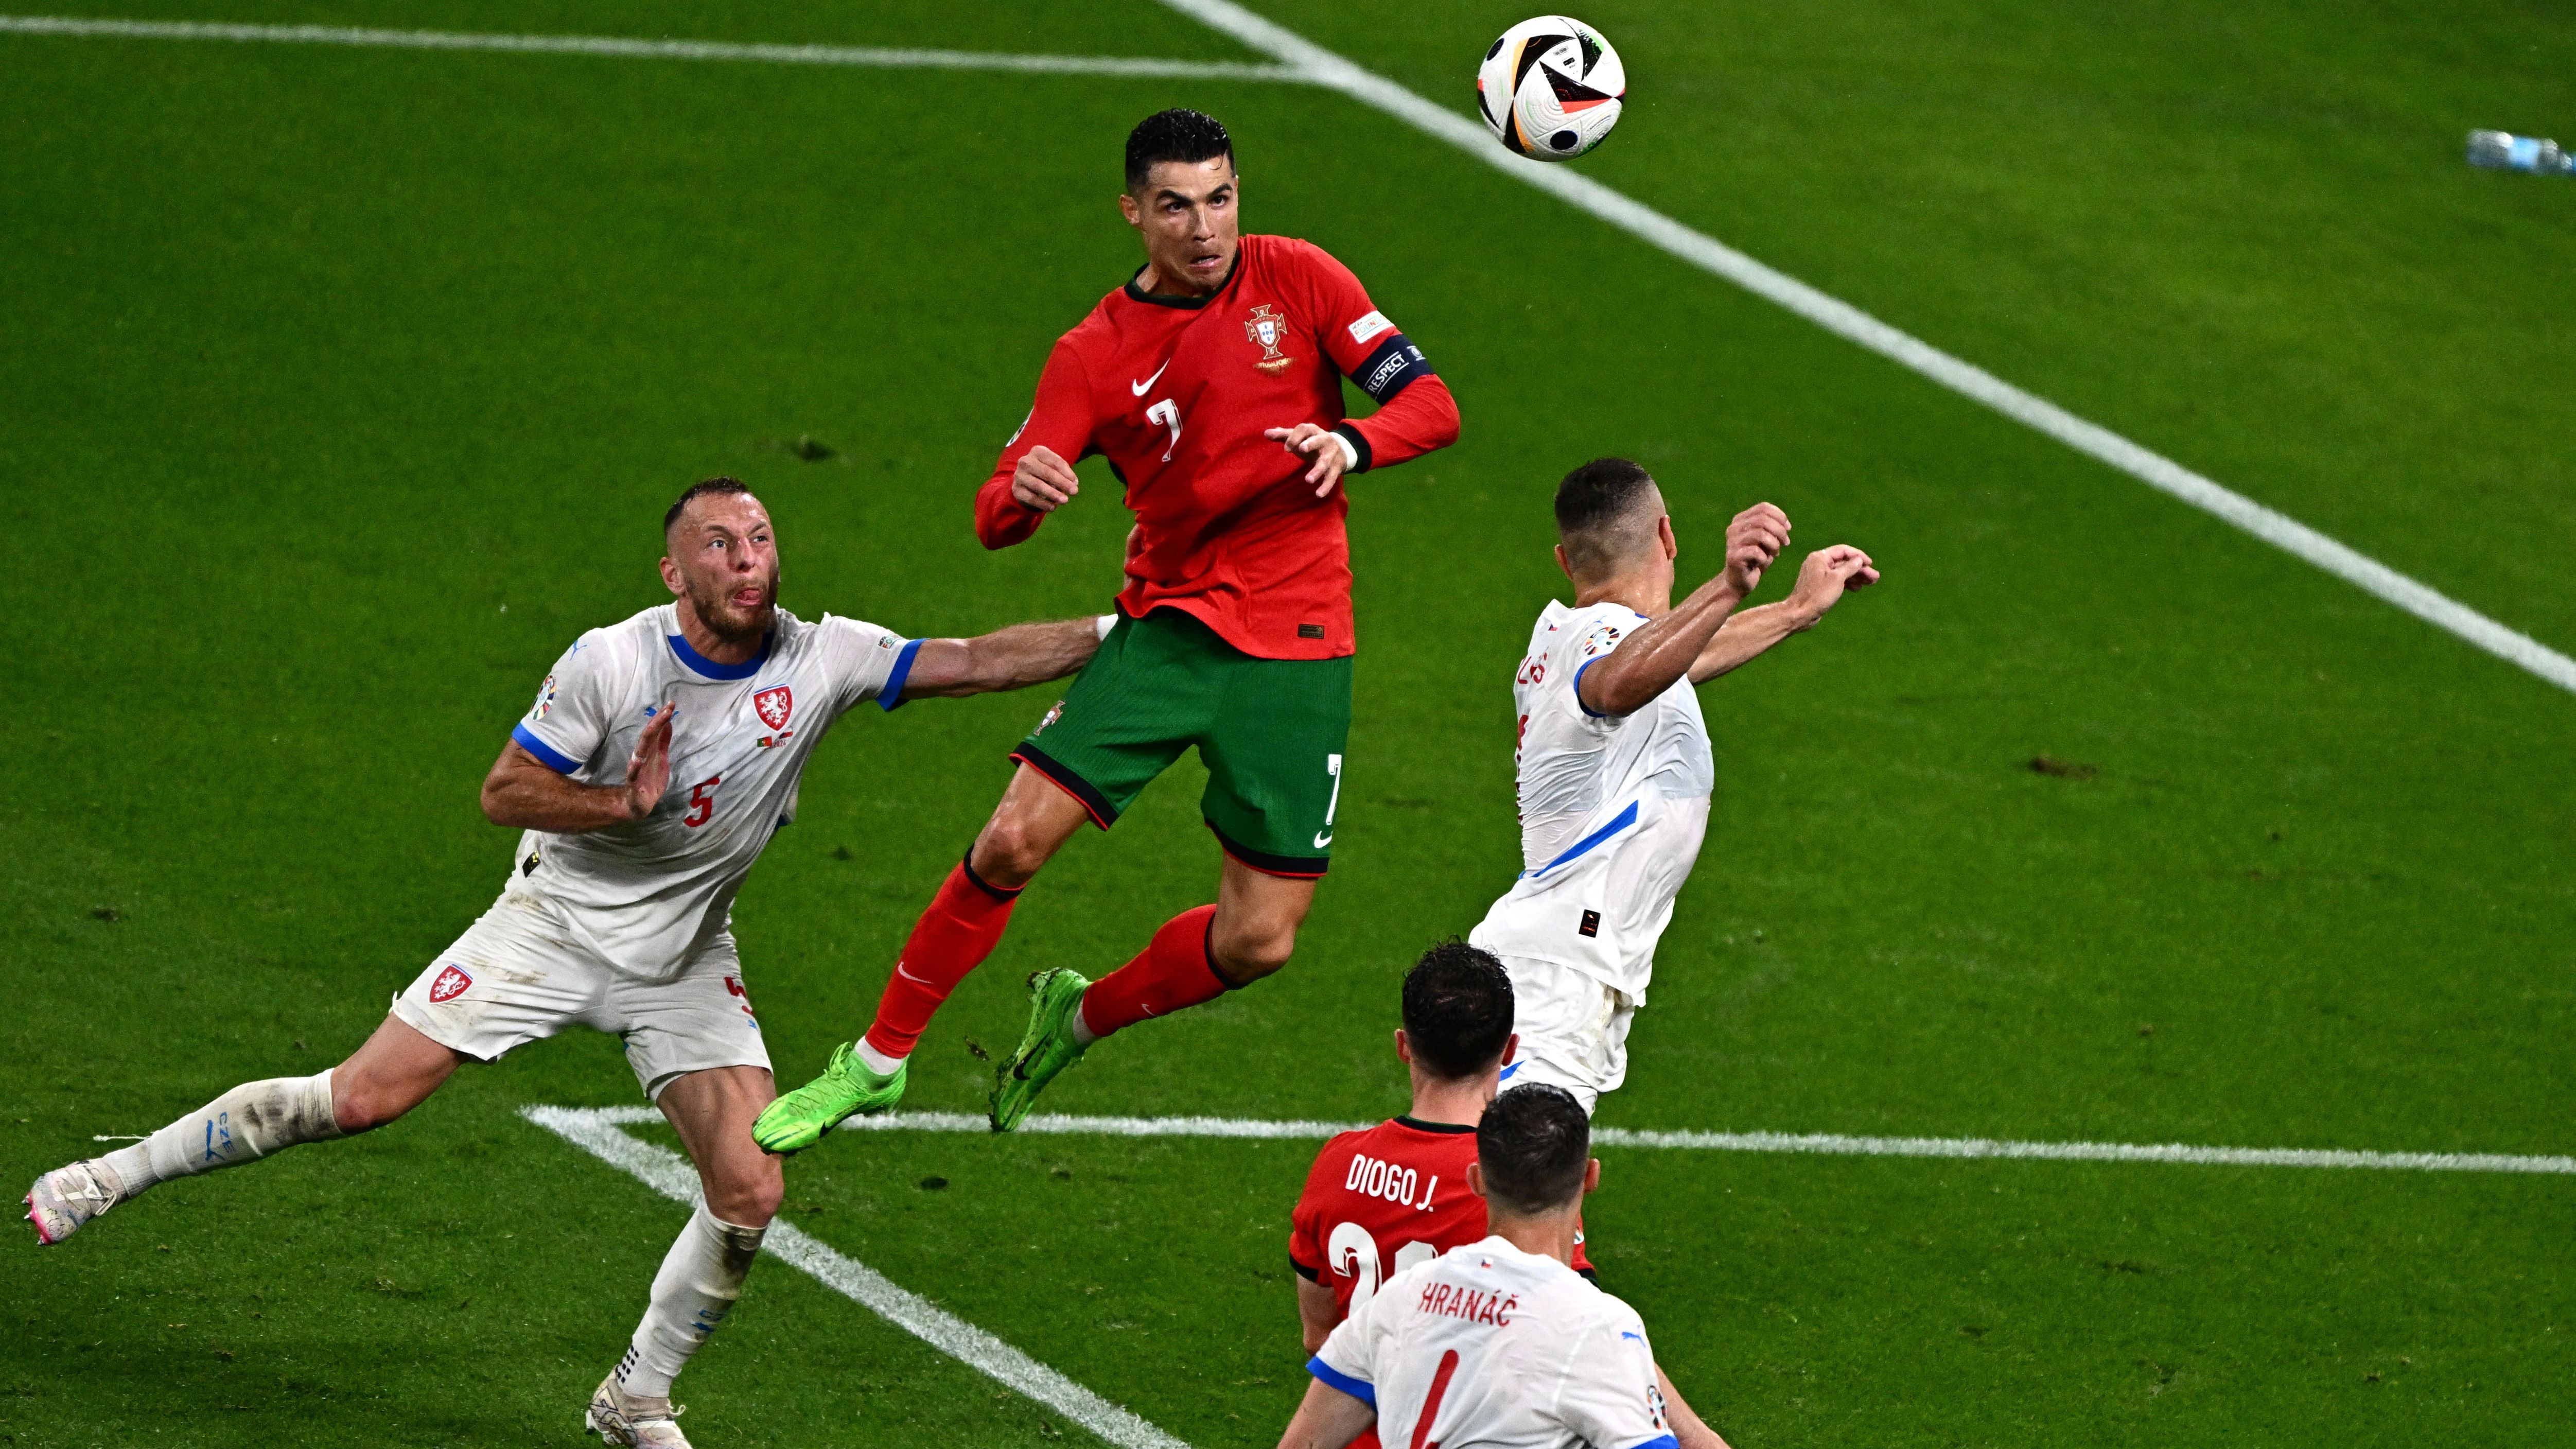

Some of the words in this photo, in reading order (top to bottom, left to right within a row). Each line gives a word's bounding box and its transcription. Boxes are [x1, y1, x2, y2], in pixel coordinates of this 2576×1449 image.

[1368, 354, 1405, 393] RESPECT
[1146, 398, 1183, 462] 7
[684, 777, 720, 828] 5
[1325, 754, 1342, 826] 7
[219, 1112, 236, 1154] CZE
[1345, 1154, 1417, 1206] DIOGO
[1416, 1175, 1438, 1212] J.
[1328, 1221, 1439, 1319] 2
[1418, 1282, 1519, 1328] HRANÁČ
